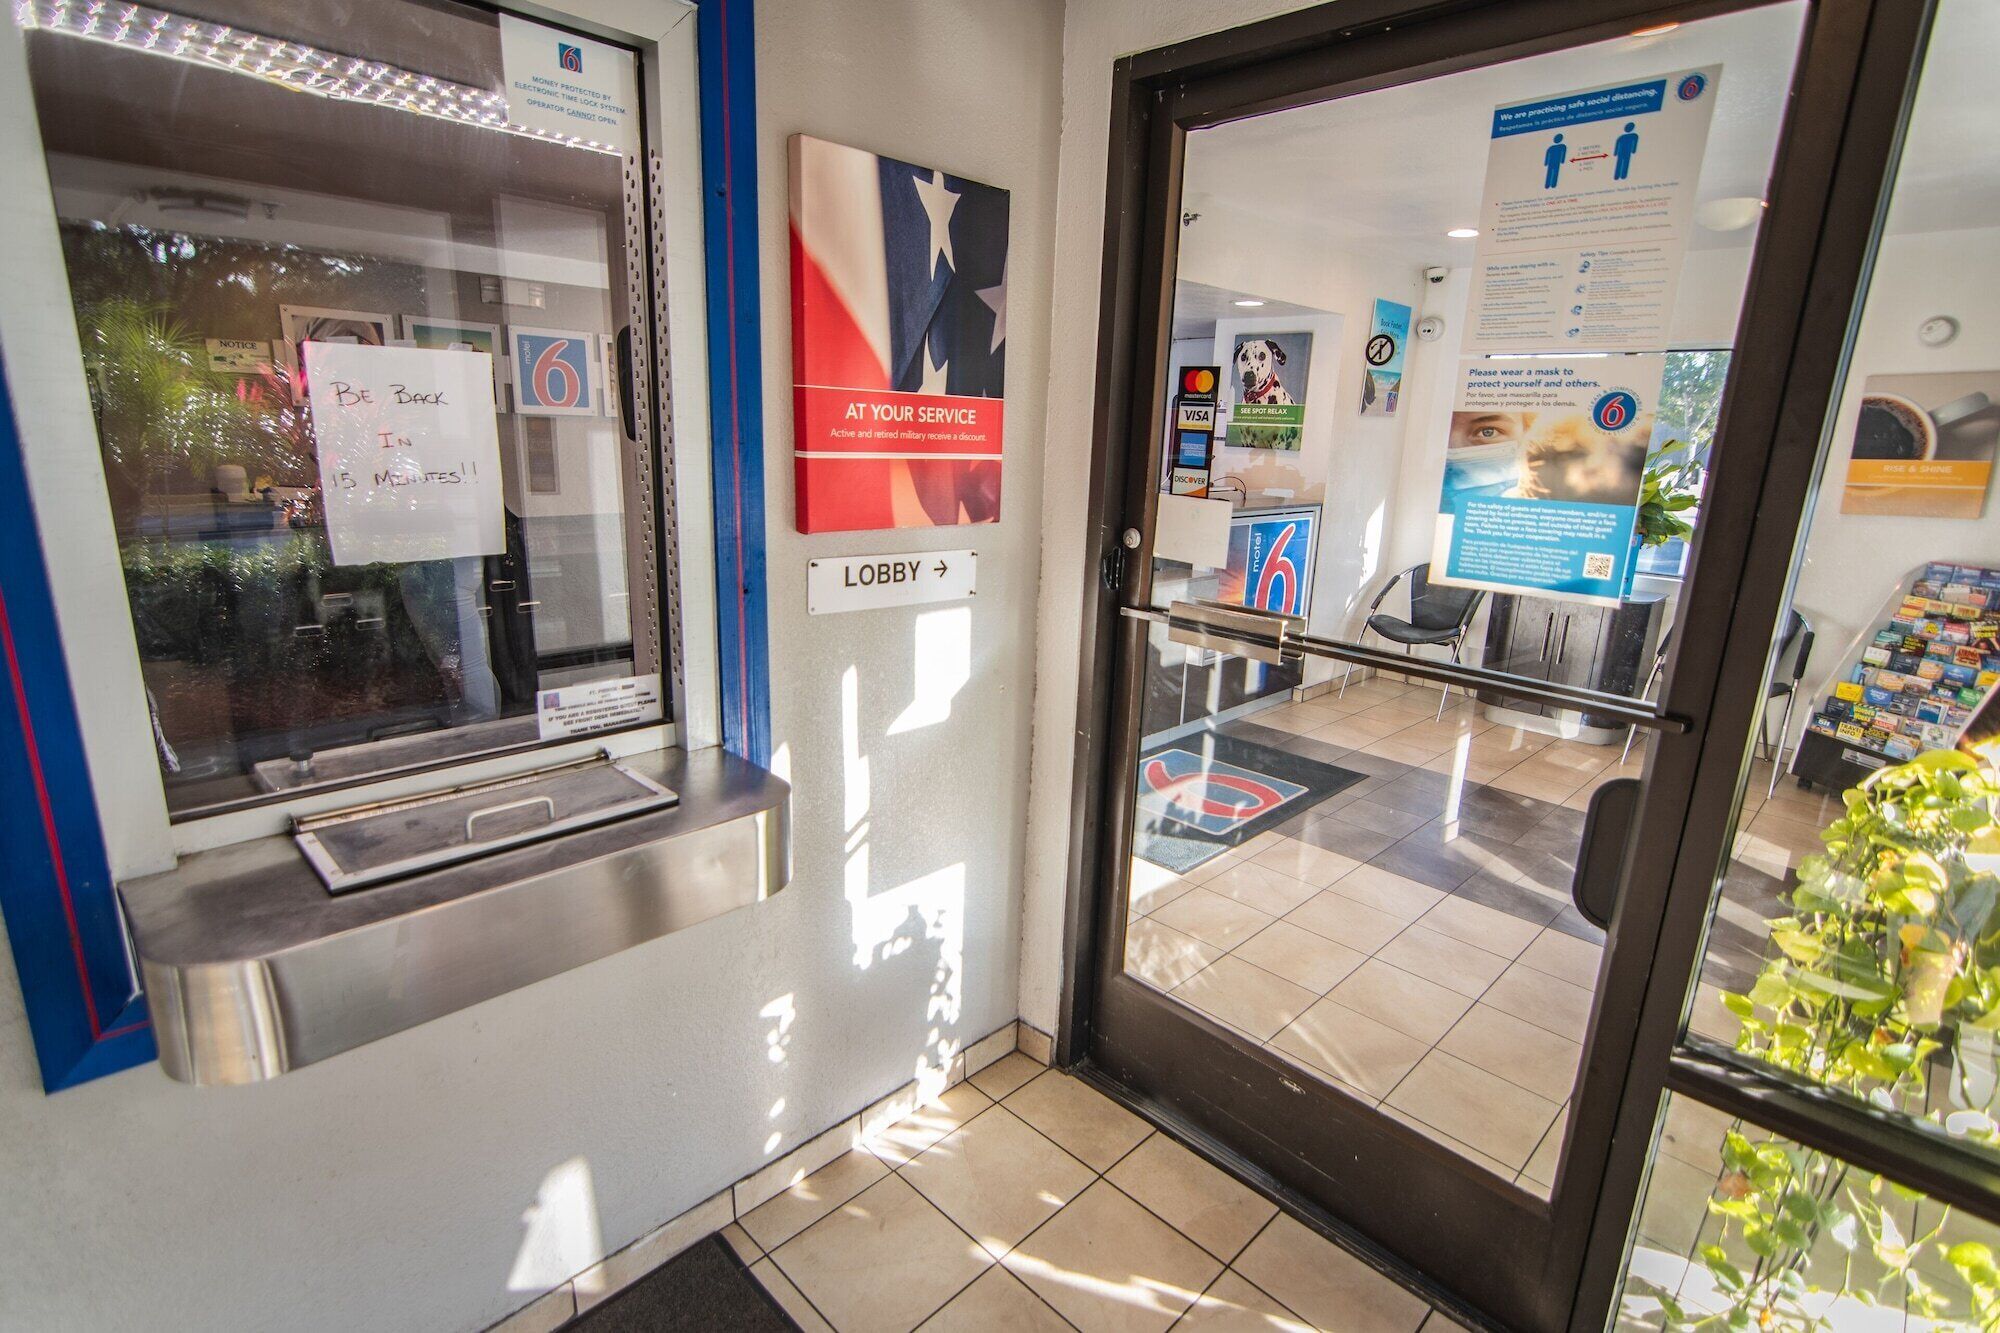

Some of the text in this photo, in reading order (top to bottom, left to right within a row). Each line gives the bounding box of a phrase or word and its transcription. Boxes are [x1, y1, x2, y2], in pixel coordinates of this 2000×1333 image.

[563, 47, 579, 72] 6
[515, 81, 559, 97] ELECTRONIC
[562, 93, 577, 102] TIME
[580, 99, 598, 108] LOCK
[532, 76, 558, 87] MONEY
[561, 83, 600, 99] PROTECTED
[527, 98, 565, 113] OPERATOR
[566, 108, 595, 121] CANNOT
[1500, 113, 1512, 121] We
[1514, 111, 1526, 119] are
[1528, 104, 1566, 118] practicing
[1568, 100, 1585, 109] safe
[1586, 95, 1610, 106] social
[220, 340, 257, 349] NOTICE
[521, 340, 531, 365] motel
[532, 340, 580, 408] 6
[1469, 368, 1498, 377] Please
[1535, 368, 1559, 376] mask
[1563, 368, 1573, 376] to
[1467, 379, 1601, 390] protect yourself and others.
[844, 402, 977, 425] AT YOUR SERVICE
[1184, 409, 1209, 422] VISA
[1601, 395, 1625, 427] 6
[830, 428, 855, 438] Active
[857, 428, 873, 438] and
[874, 428, 899, 439] retired
[900, 430, 926, 442] military
[927, 432, 952, 441] receive
[958, 431, 987, 442] discount.
[332, 472, 357, 489] 15
[1174, 475, 1205, 485] DISCOVER
[1883, 464, 1953, 474] RISE & SHINE
[1253, 531, 1263, 573] motel
[844, 560, 921, 588] LOBBY
[1254, 522, 1298, 616] 6
[1840, 723, 1862, 733] TRAVEL
[1840, 728, 1855, 736] INFO
